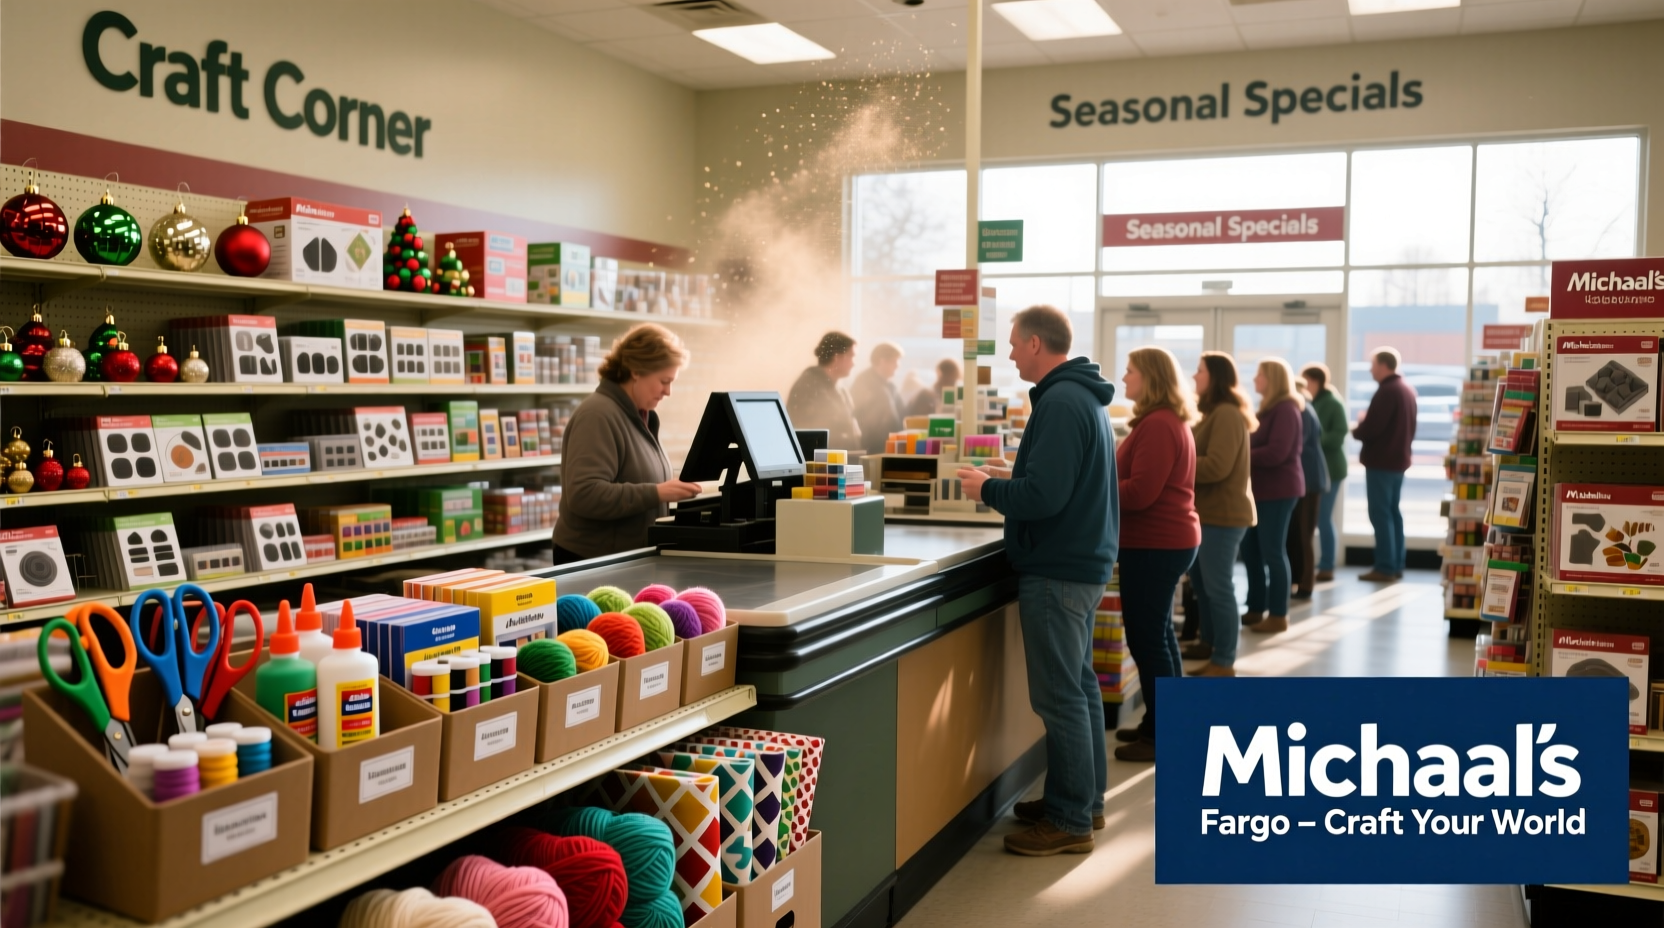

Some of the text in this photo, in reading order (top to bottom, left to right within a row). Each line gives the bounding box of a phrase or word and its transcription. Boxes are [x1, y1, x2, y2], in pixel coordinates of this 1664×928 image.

[80, 9, 431, 158] Craft Corner
[1049, 69, 1424, 129] Seasonal Specials
[1125, 213, 1319, 242] Seasonal Specials
[1566, 269, 1664, 292] Michaal's
